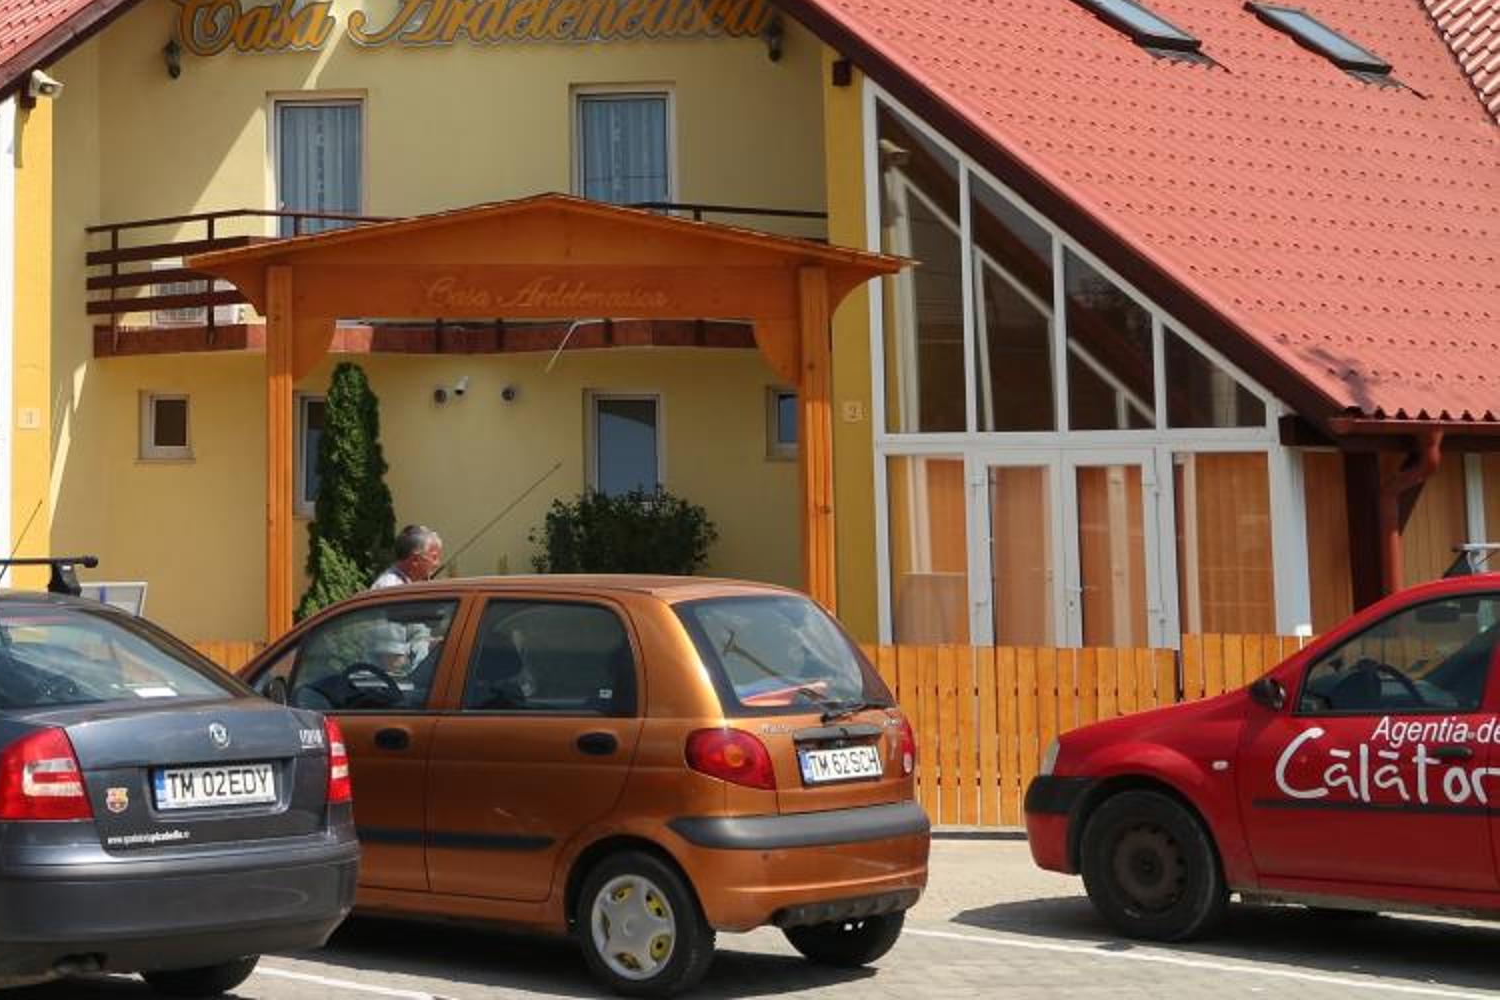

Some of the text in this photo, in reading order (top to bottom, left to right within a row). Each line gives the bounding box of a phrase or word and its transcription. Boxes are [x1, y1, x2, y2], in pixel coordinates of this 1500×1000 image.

[1372, 716, 1468, 748] Agentia
[808, 750, 879, 776] TM 62SCH
[167, 768, 269, 799] TM 02EDY
